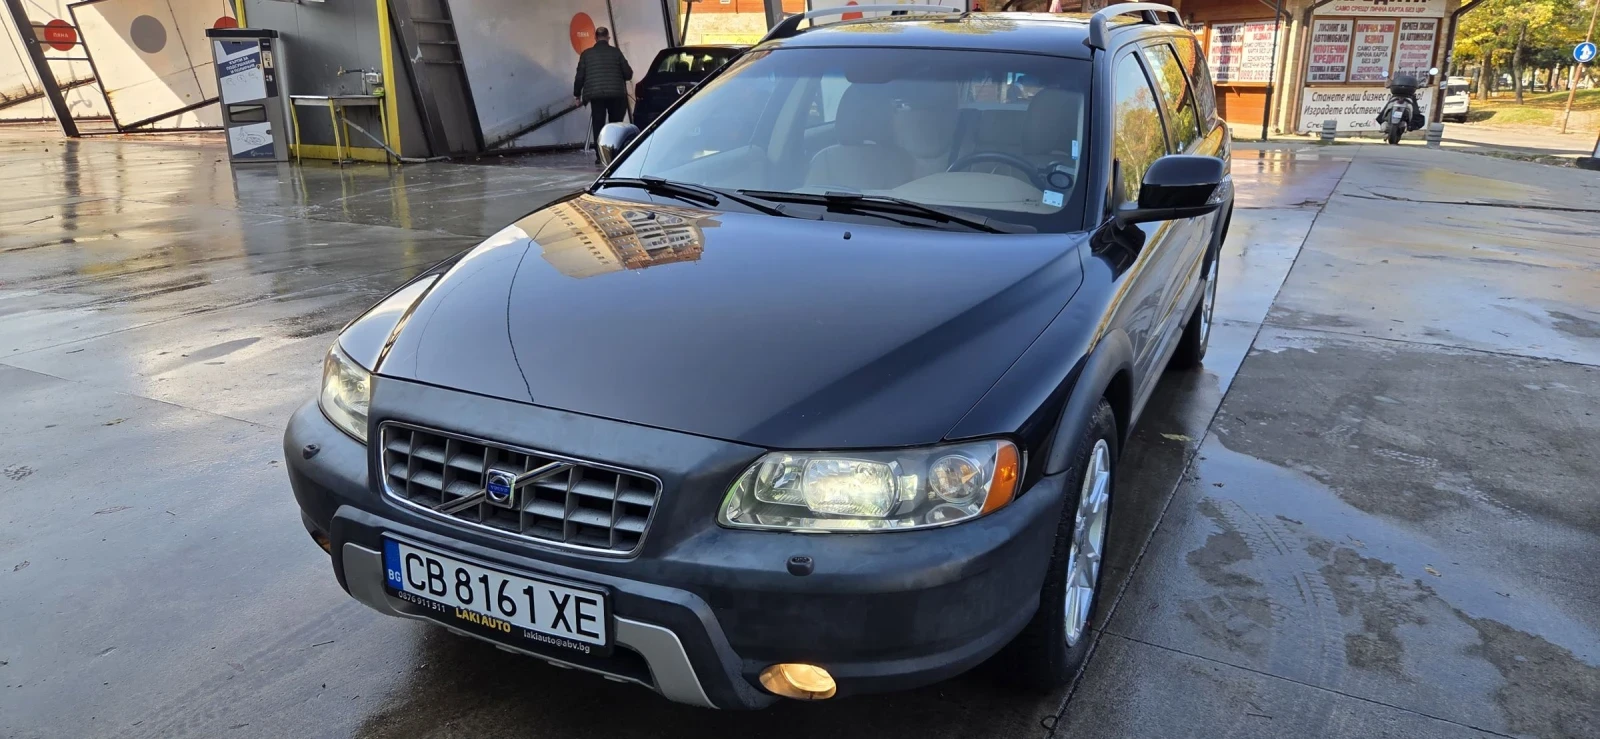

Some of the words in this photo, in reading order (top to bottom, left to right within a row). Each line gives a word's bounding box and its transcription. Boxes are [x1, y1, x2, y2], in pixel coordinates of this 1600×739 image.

[1340, 24, 1347, 32] НА
[1314, 34, 1350, 42] АВТОМОБИЛИ
[1313, 45, 1348, 53] ИПОТЕЧНИ
[1313, 55, 1344, 64] КРЕДИТИ
[1312, 92, 1345, 102] Станете
[1346, 93, 1360, 101] наш
[1362, 91, 1384, 101] бизнес
[1304, 105, 1343, 116] Изградете
[1344, 104, 1381, 114] собствена
[388, 568, 401, 582] BG
[405, 552, 447, 597] CB
[454, 567, 536, 625] 8161
[548, 590, 600, 640] XE
[417, 598, 430, 608] 911
[432, 602, 446, 613] 511
[524, 629, 590, 654] lakiauto@abv.bg
